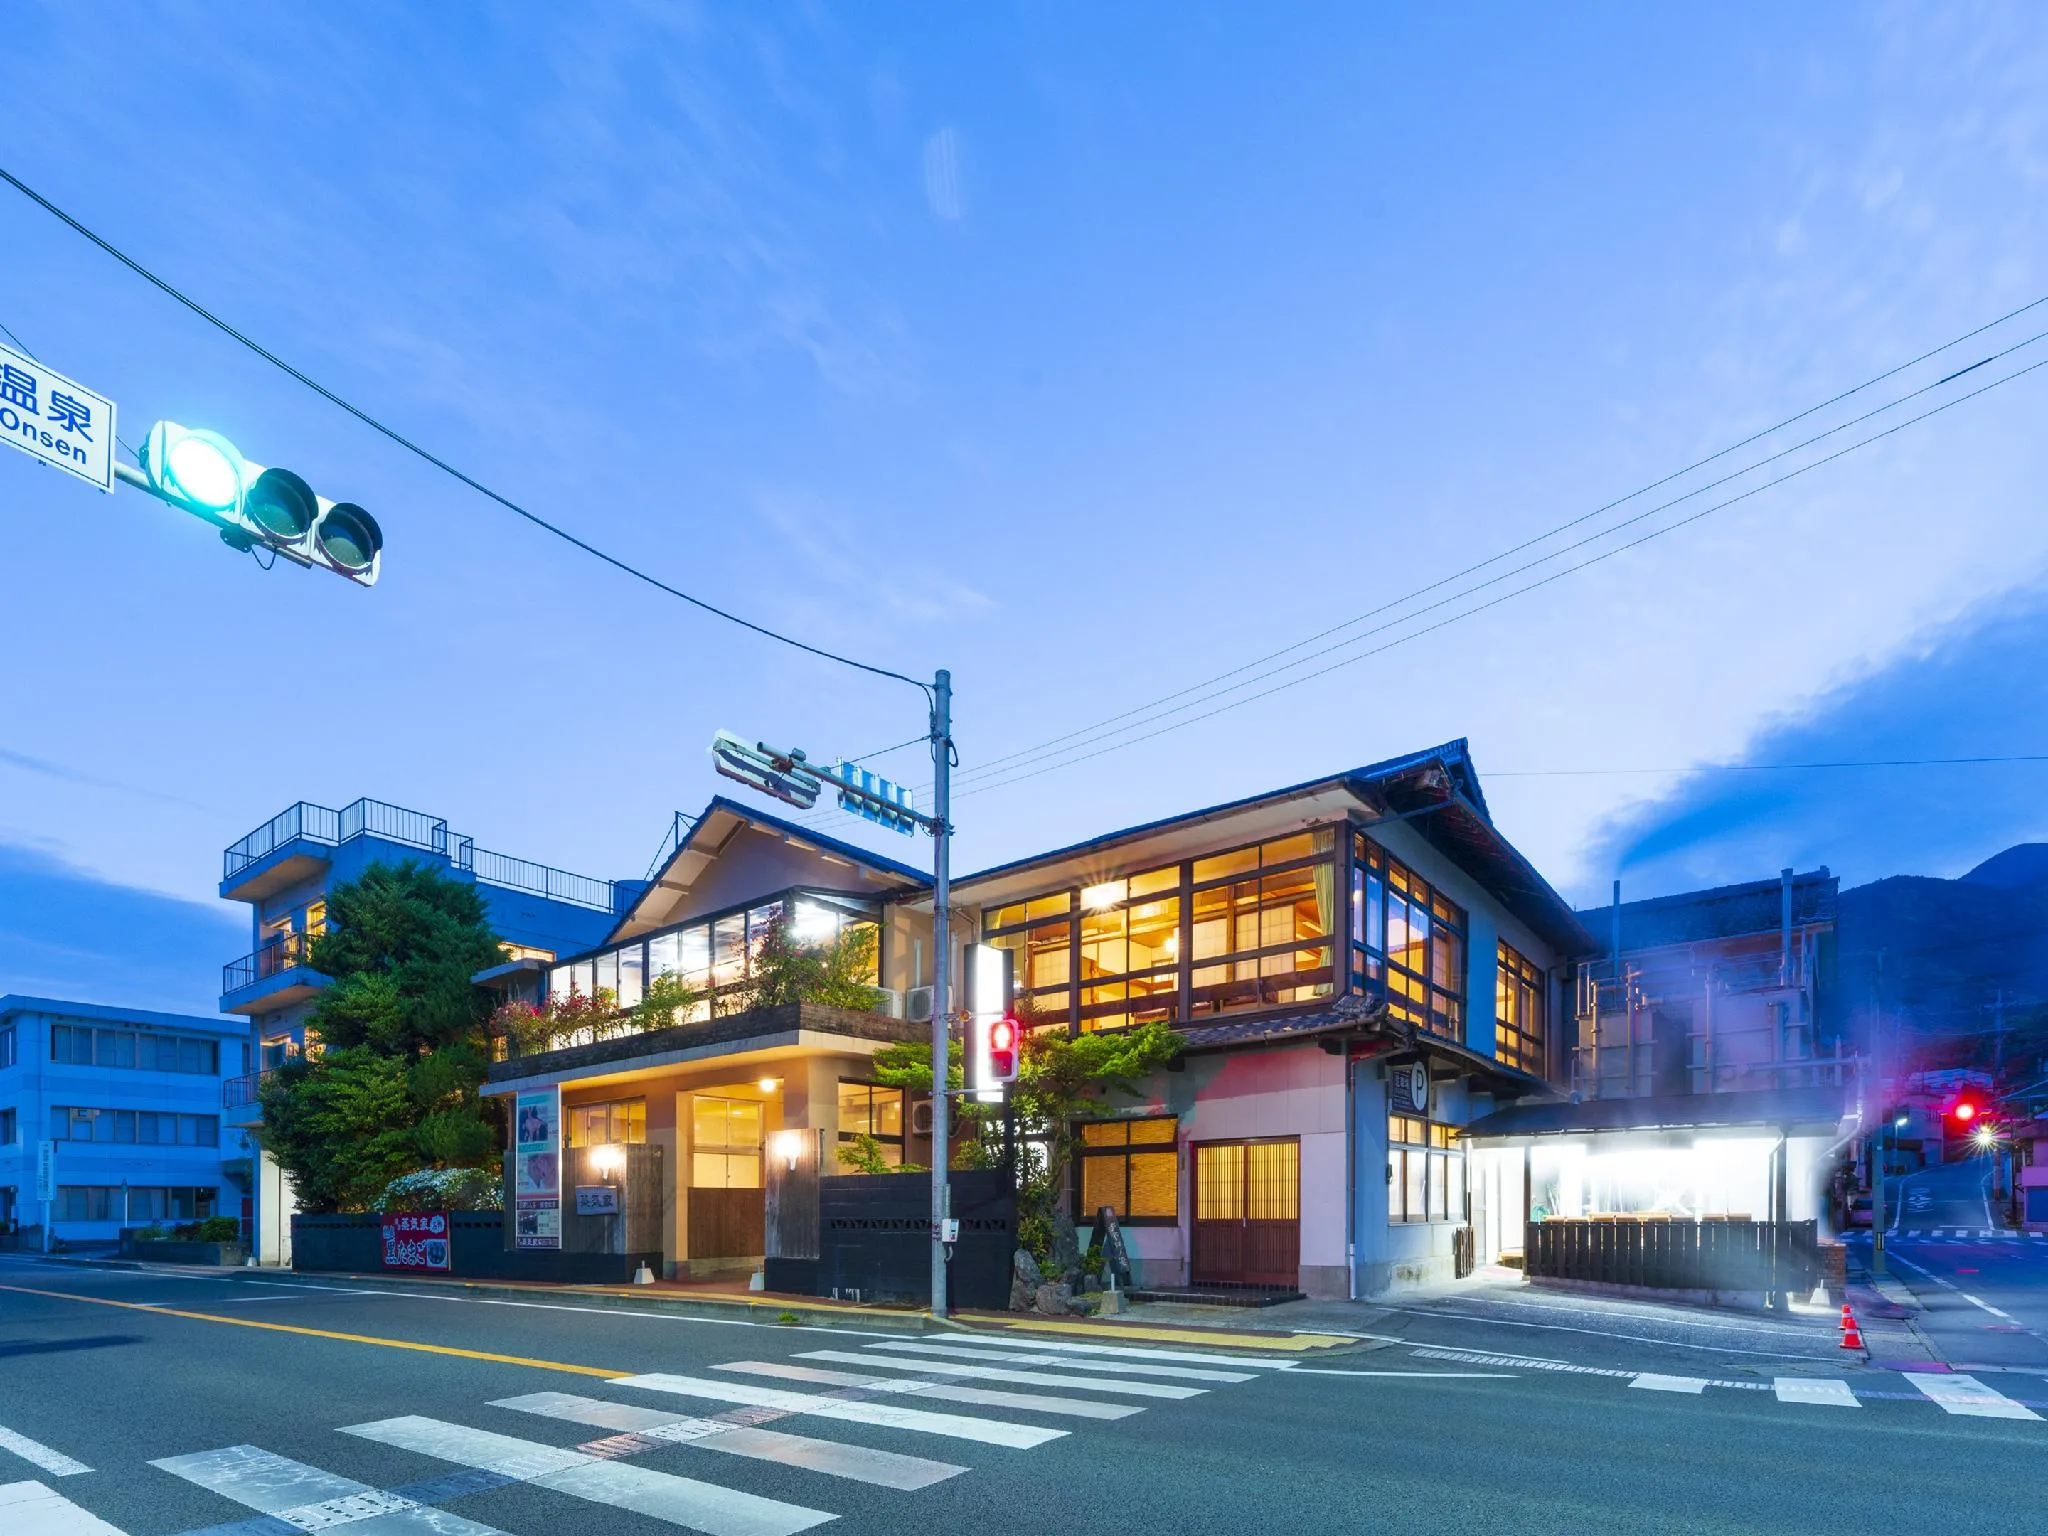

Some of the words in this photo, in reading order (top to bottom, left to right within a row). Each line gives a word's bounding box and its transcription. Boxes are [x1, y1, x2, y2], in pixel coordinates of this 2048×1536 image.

[0, 363, 94, 442] 温泉
[0, 407, 87, 464] Onsen
[1416, 1069, 1424, 1105] P
